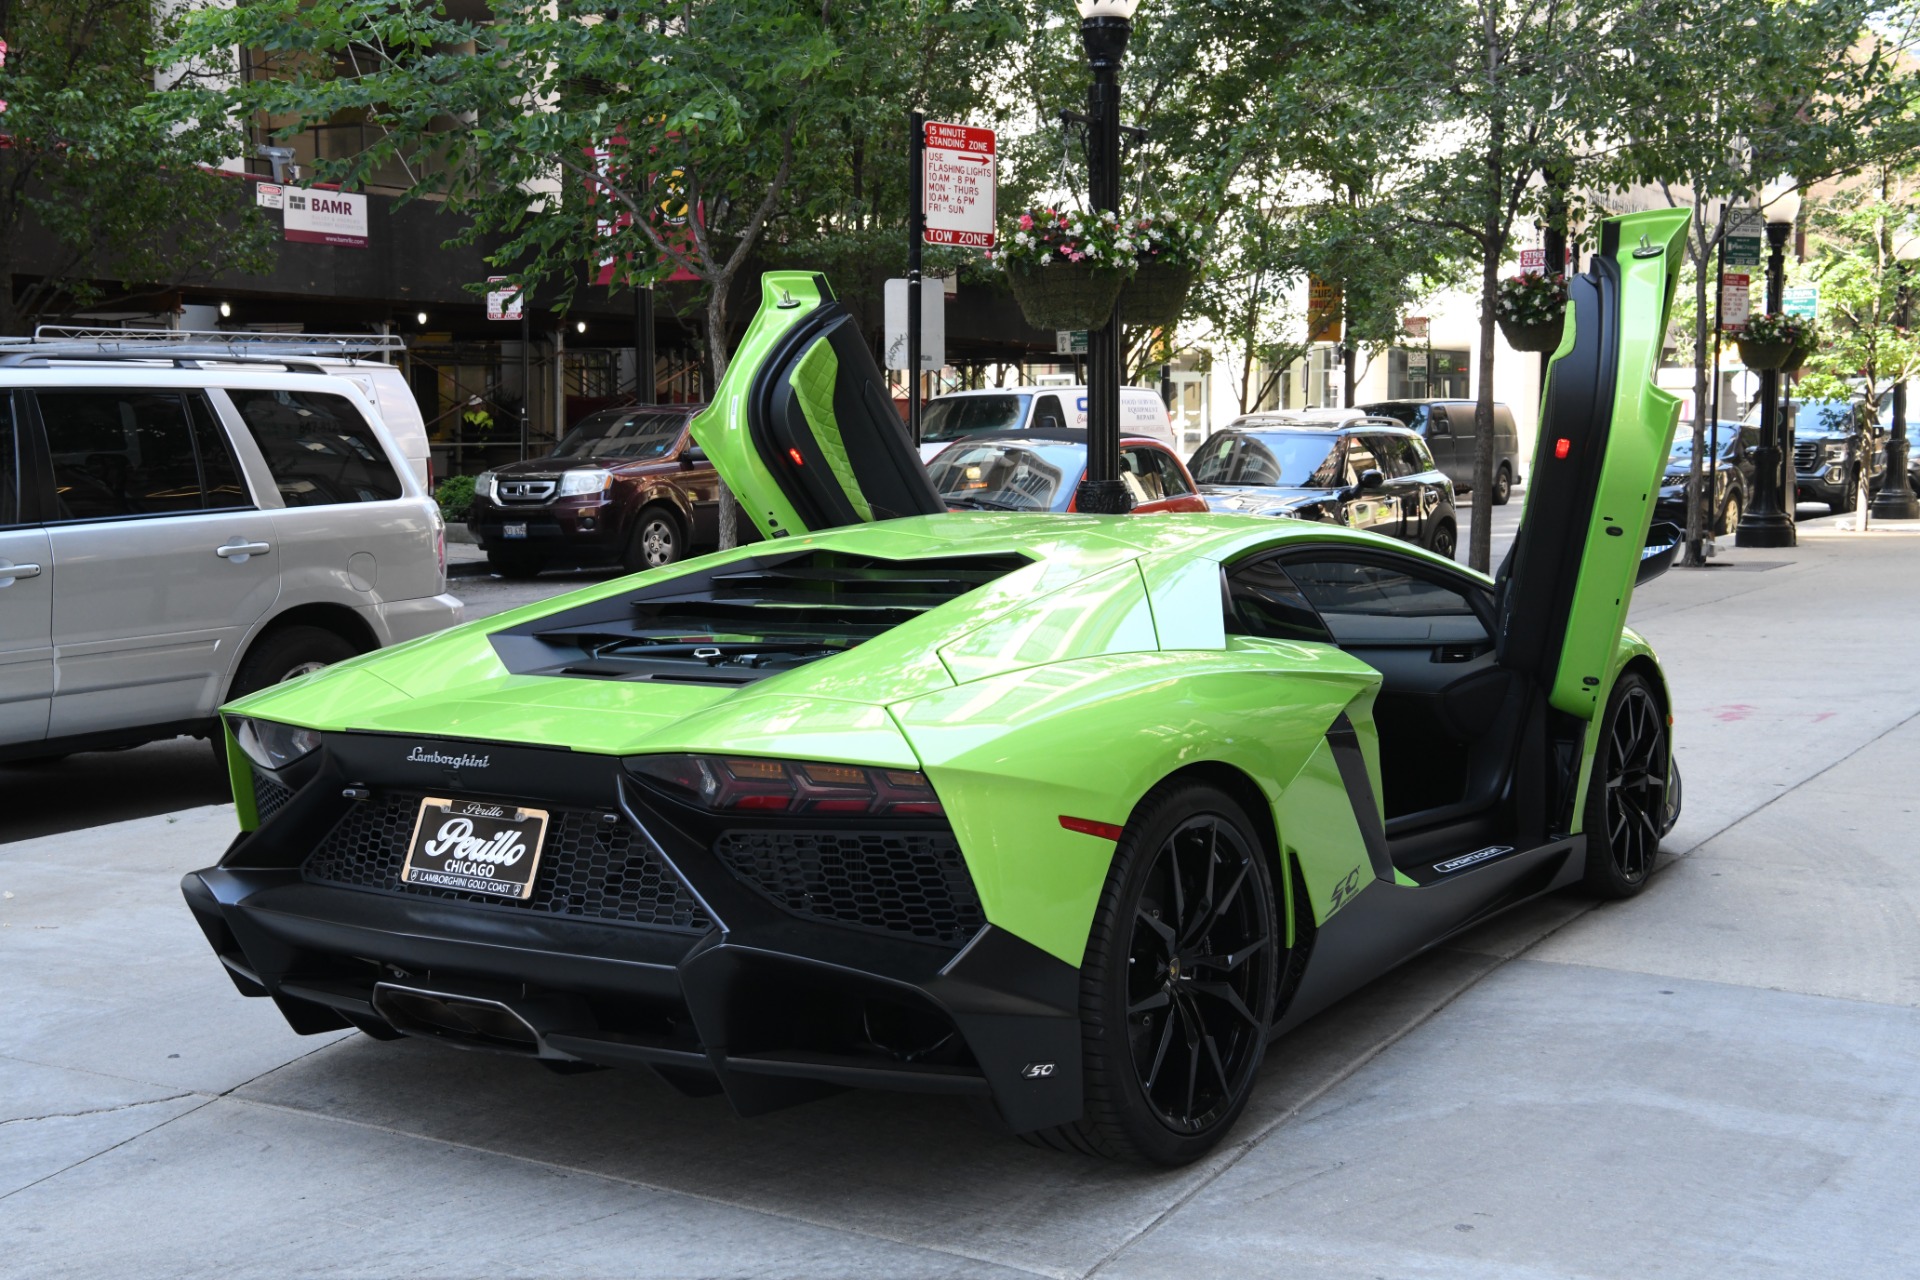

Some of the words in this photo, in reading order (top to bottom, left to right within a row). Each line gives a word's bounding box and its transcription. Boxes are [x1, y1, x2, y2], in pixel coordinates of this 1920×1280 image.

[929, 126, 936, 135] 15
[939, 127, 966, 138] MINUTE
[929, 136, 965, 149] STANDING
[968, 141, 988, 151] ZONE
[929, 153, 943, 162] USE
[929, 163, 965, 175] FLASHING
[966, 167, 991, 178] LIGHTS
[957, 176, 962, 184] 8
[964, 177, 976, 185] PM
[929, 183, 945, 192] MON
[954, 185, 979, 196] THURS
[311, 198, 352, 215] BAMR
[957, 196, 962, 205] 6
[964, 197, 975, 205] PM
[929, 203, 941, 212] FRI
[948, 205, 964, 214] SUN
[929, 230, 953, 242] TOW
[959, 232, 988, 245] ZONE
[407, 746, 490, 768] Lamborghini
[463, 803, 504, 817] Perillo
[425, 818, 526, 866] Perillo
[444, 859, 495, 877] CHICAGO
[420, 872, 467, 887] LAMBORGHINI
[468, 879, 487, 890] GOLD
[488, 882, 510, 893] COAST
